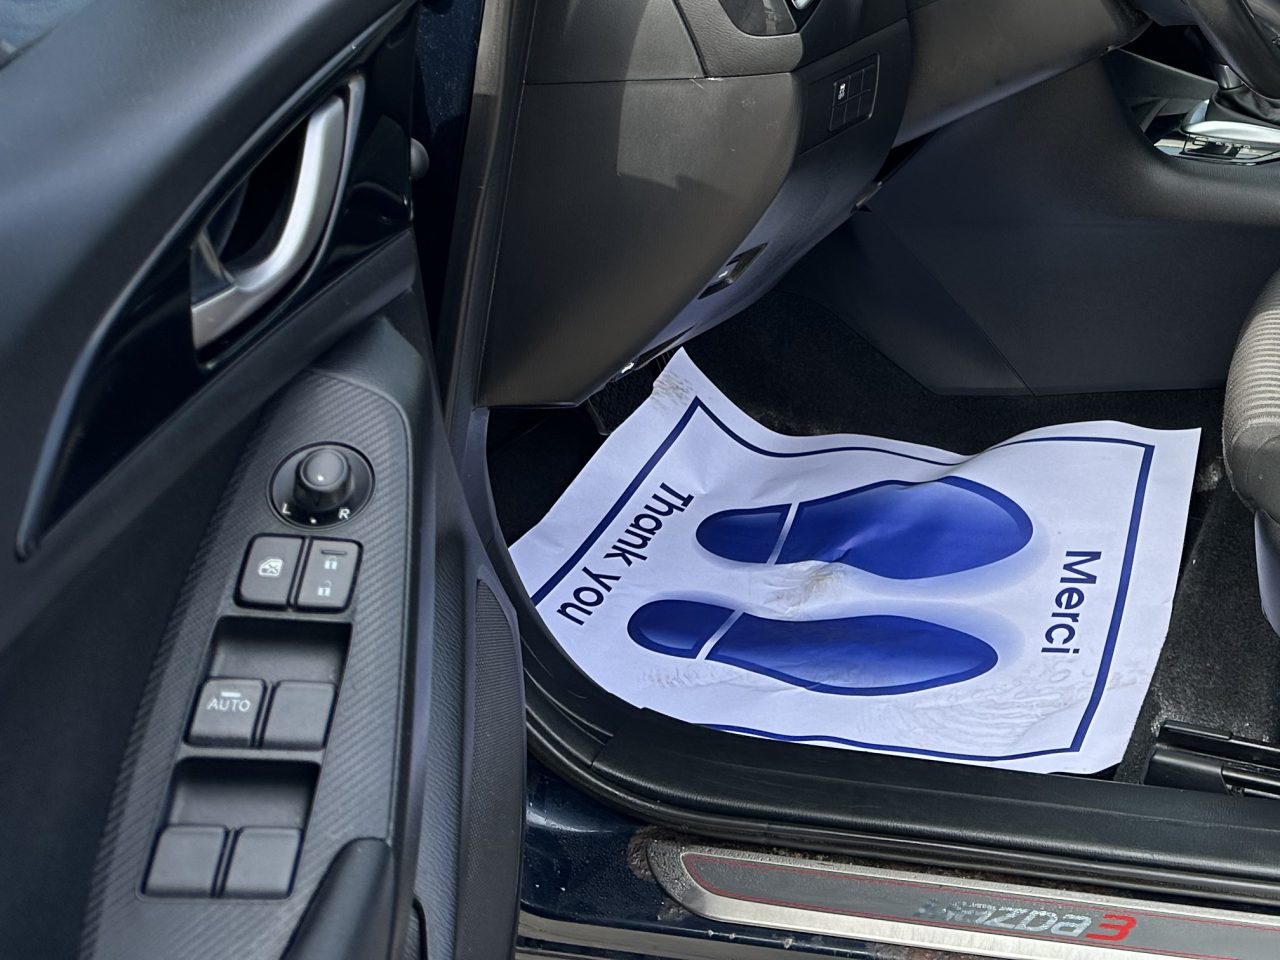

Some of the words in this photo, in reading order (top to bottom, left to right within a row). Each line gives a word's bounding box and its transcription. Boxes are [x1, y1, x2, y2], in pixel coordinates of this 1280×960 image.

[282, 503, 291, 515] L
[338, 507, 350, 520] R
[603, 482, 695, 567] Thank
[556, 566, 622, 626] you
[1041, 550, 1102, 654] Merci
[207, 698, 251, 711] AUTO
